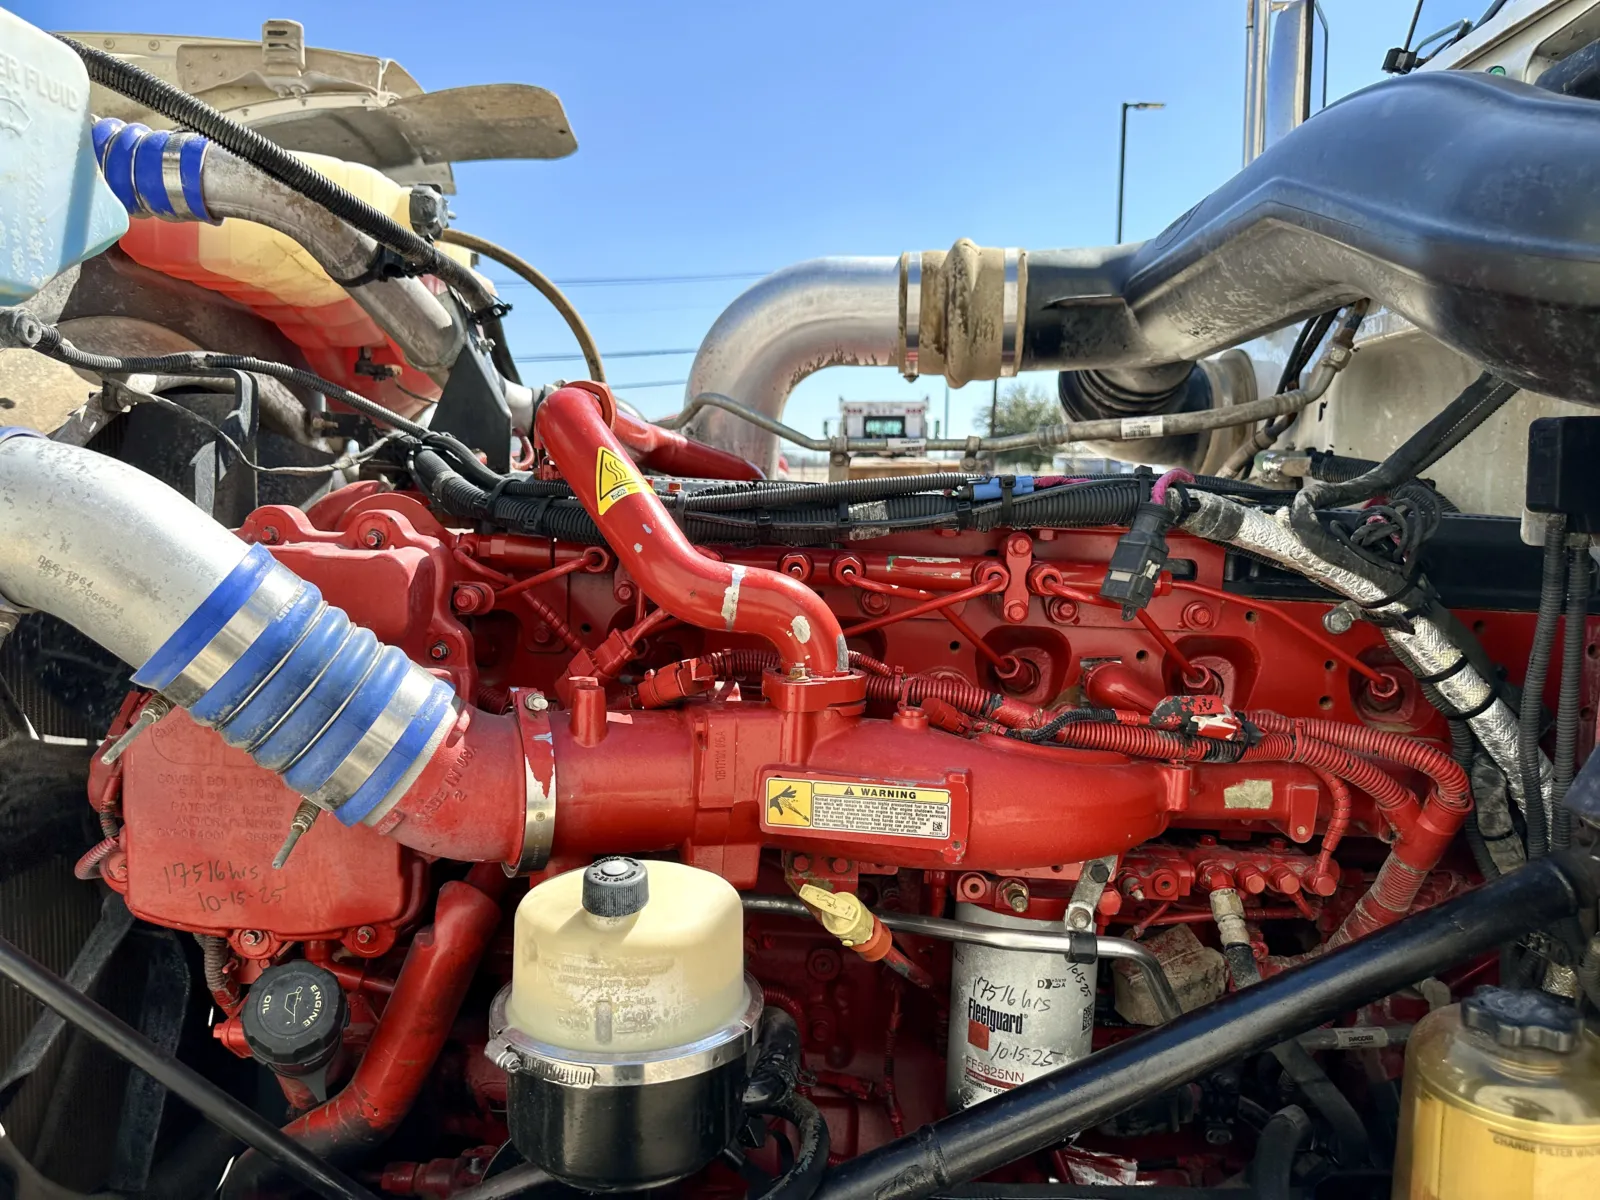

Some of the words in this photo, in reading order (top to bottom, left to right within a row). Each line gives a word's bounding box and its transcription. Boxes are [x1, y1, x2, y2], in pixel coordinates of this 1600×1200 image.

[23, 62, 80, 113] FLUID
[860, 787, 916, 800] WARNING
[262, 994, 272, 1014] OIL
[302, 984, 322, 1027] ENGINE
[968, 996, 1023, 1034] Fleetguard
[966, 1054, 1024, 1082] FF5825NN
[1492, 1134, 1536, 1154] CHANGE
[1539, 1146, 1572, 1157] FILTER
